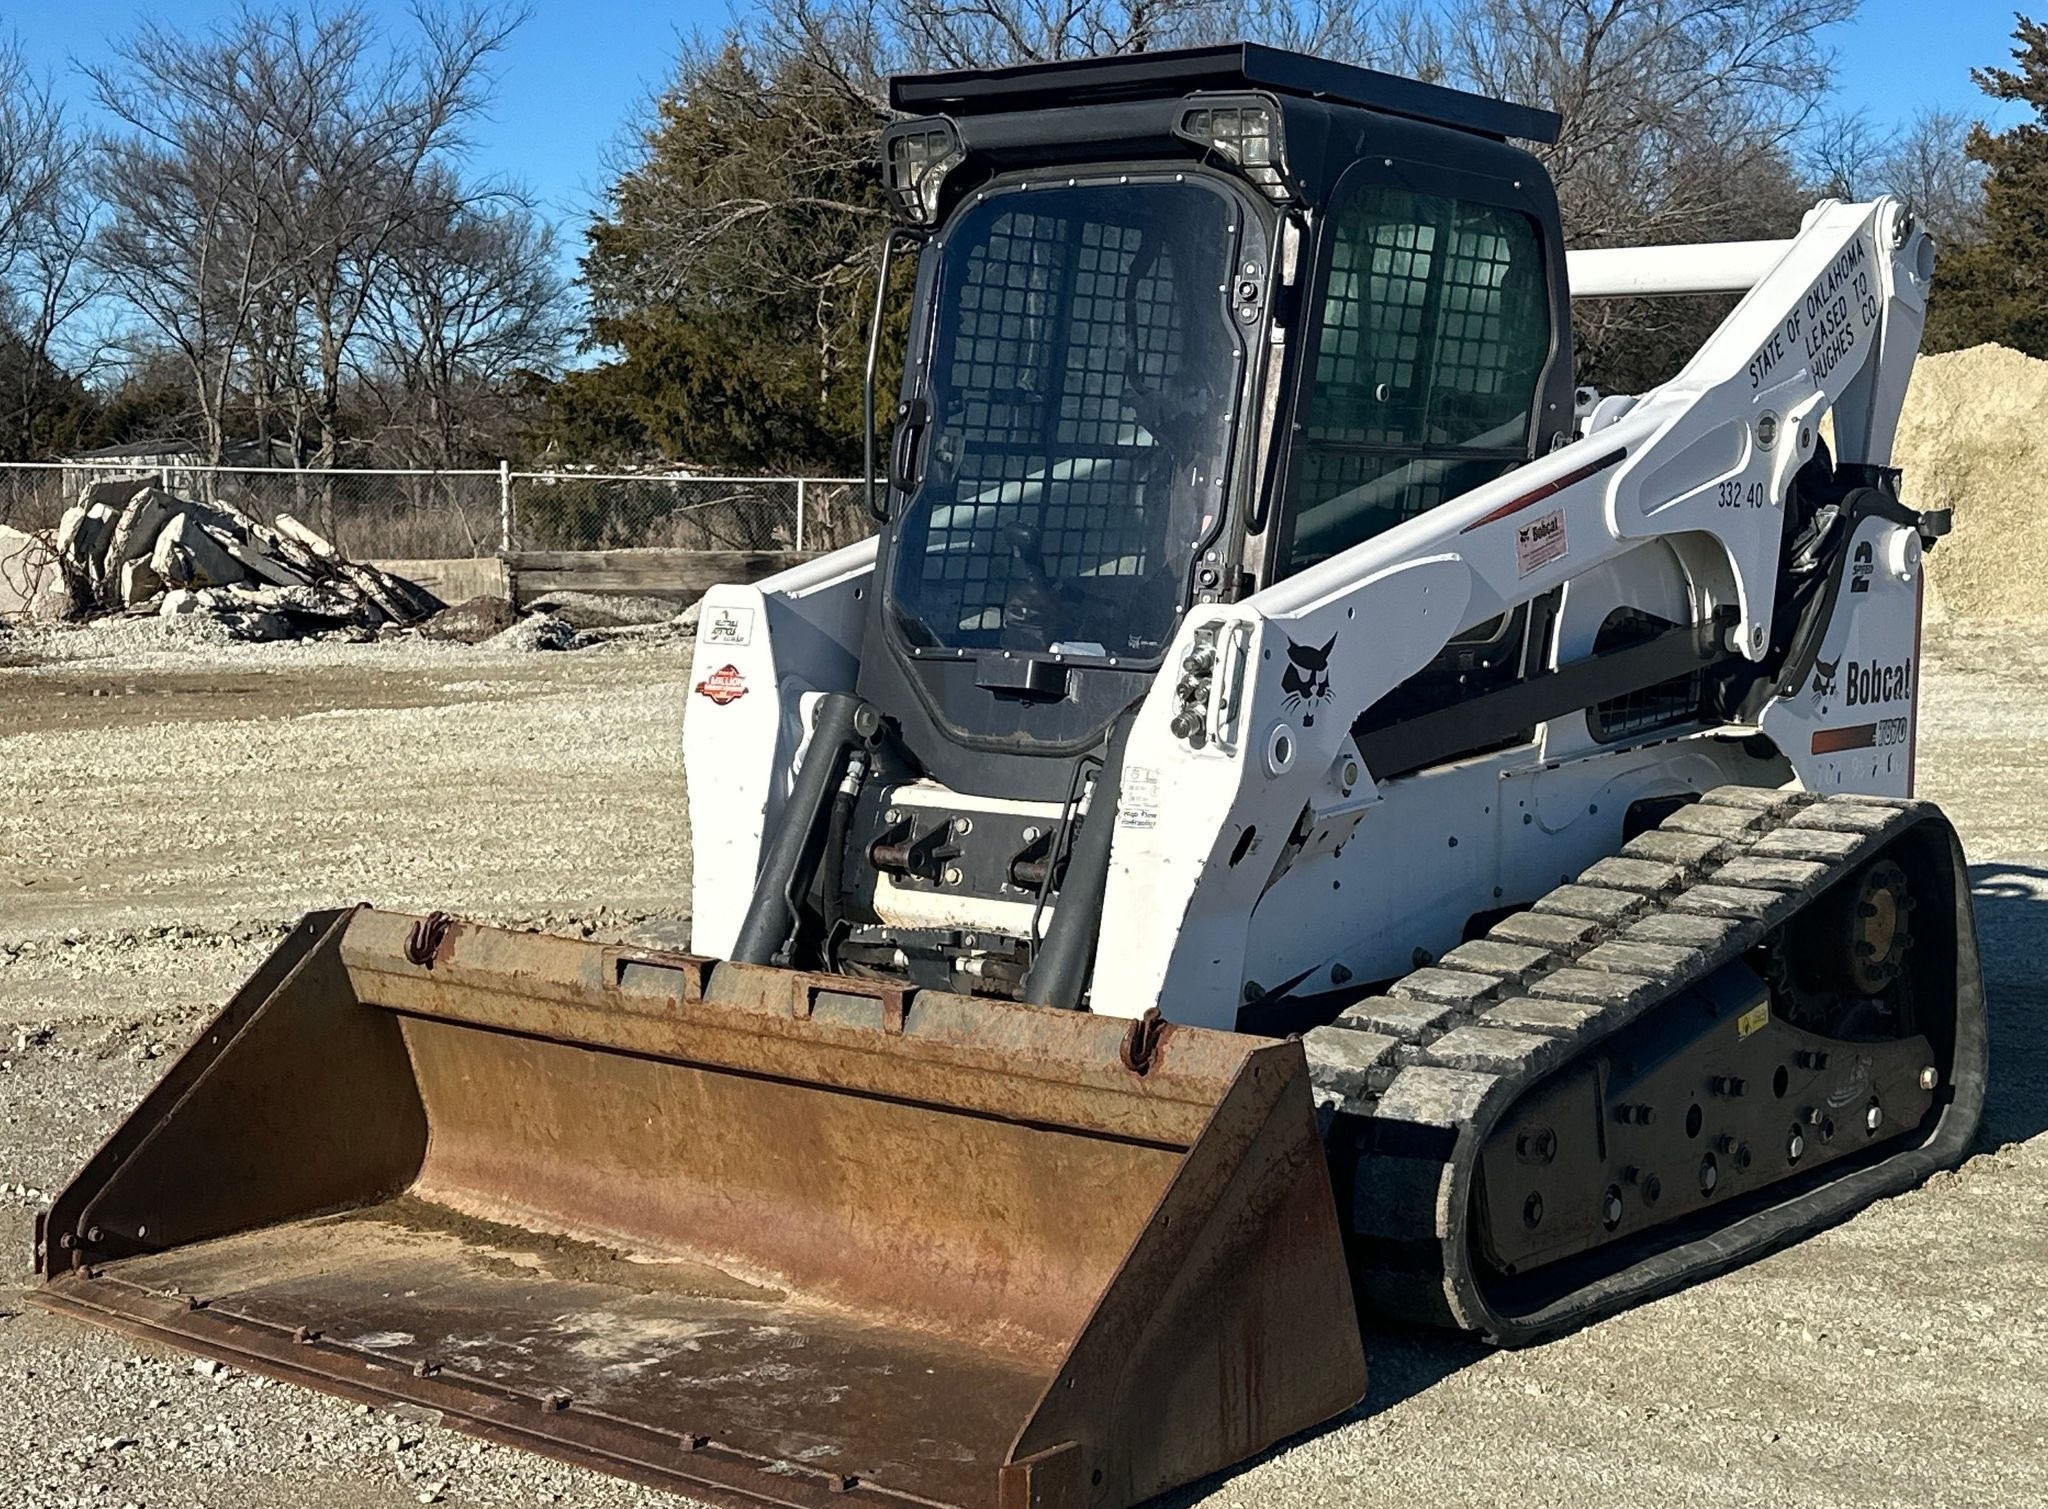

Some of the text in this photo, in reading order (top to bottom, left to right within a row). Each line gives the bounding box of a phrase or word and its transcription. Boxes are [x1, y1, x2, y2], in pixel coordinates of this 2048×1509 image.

[1749, 238, 1865, 389] STATE OF OKLAHOMA
[1804, 272, 1867, 360] LEASED TO
[1812, 295, 1876, 388] HUGHES CO
[1746, 482, 1763, 508] 40
[1846, 657, 1911, 706] Bobcat
[1878, 716, 1907, 747] T870
